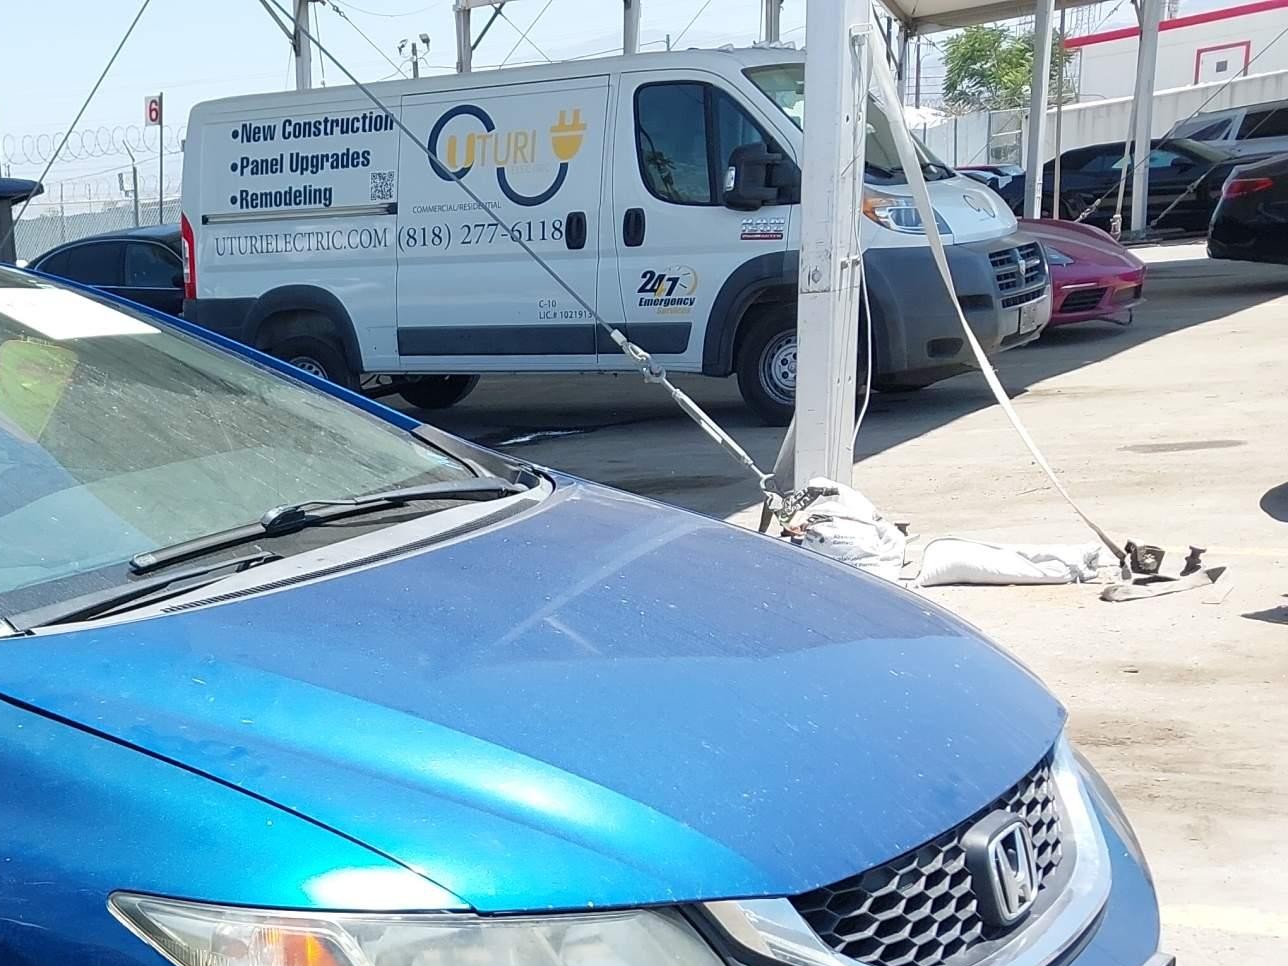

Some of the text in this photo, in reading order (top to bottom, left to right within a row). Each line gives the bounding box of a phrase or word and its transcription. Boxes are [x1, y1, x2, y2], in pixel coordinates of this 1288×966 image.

[148, 99, 159, 122] 6
[282, 111, 394, 140] Construction
[289, 148, 371, 175] Upgrades
[215, 219, 563, 256] UTURIELECTRIC.COM (818) 277-6118
[538, 299, 557, 308] C-10
[638, 297, 696, 308] Emergency
